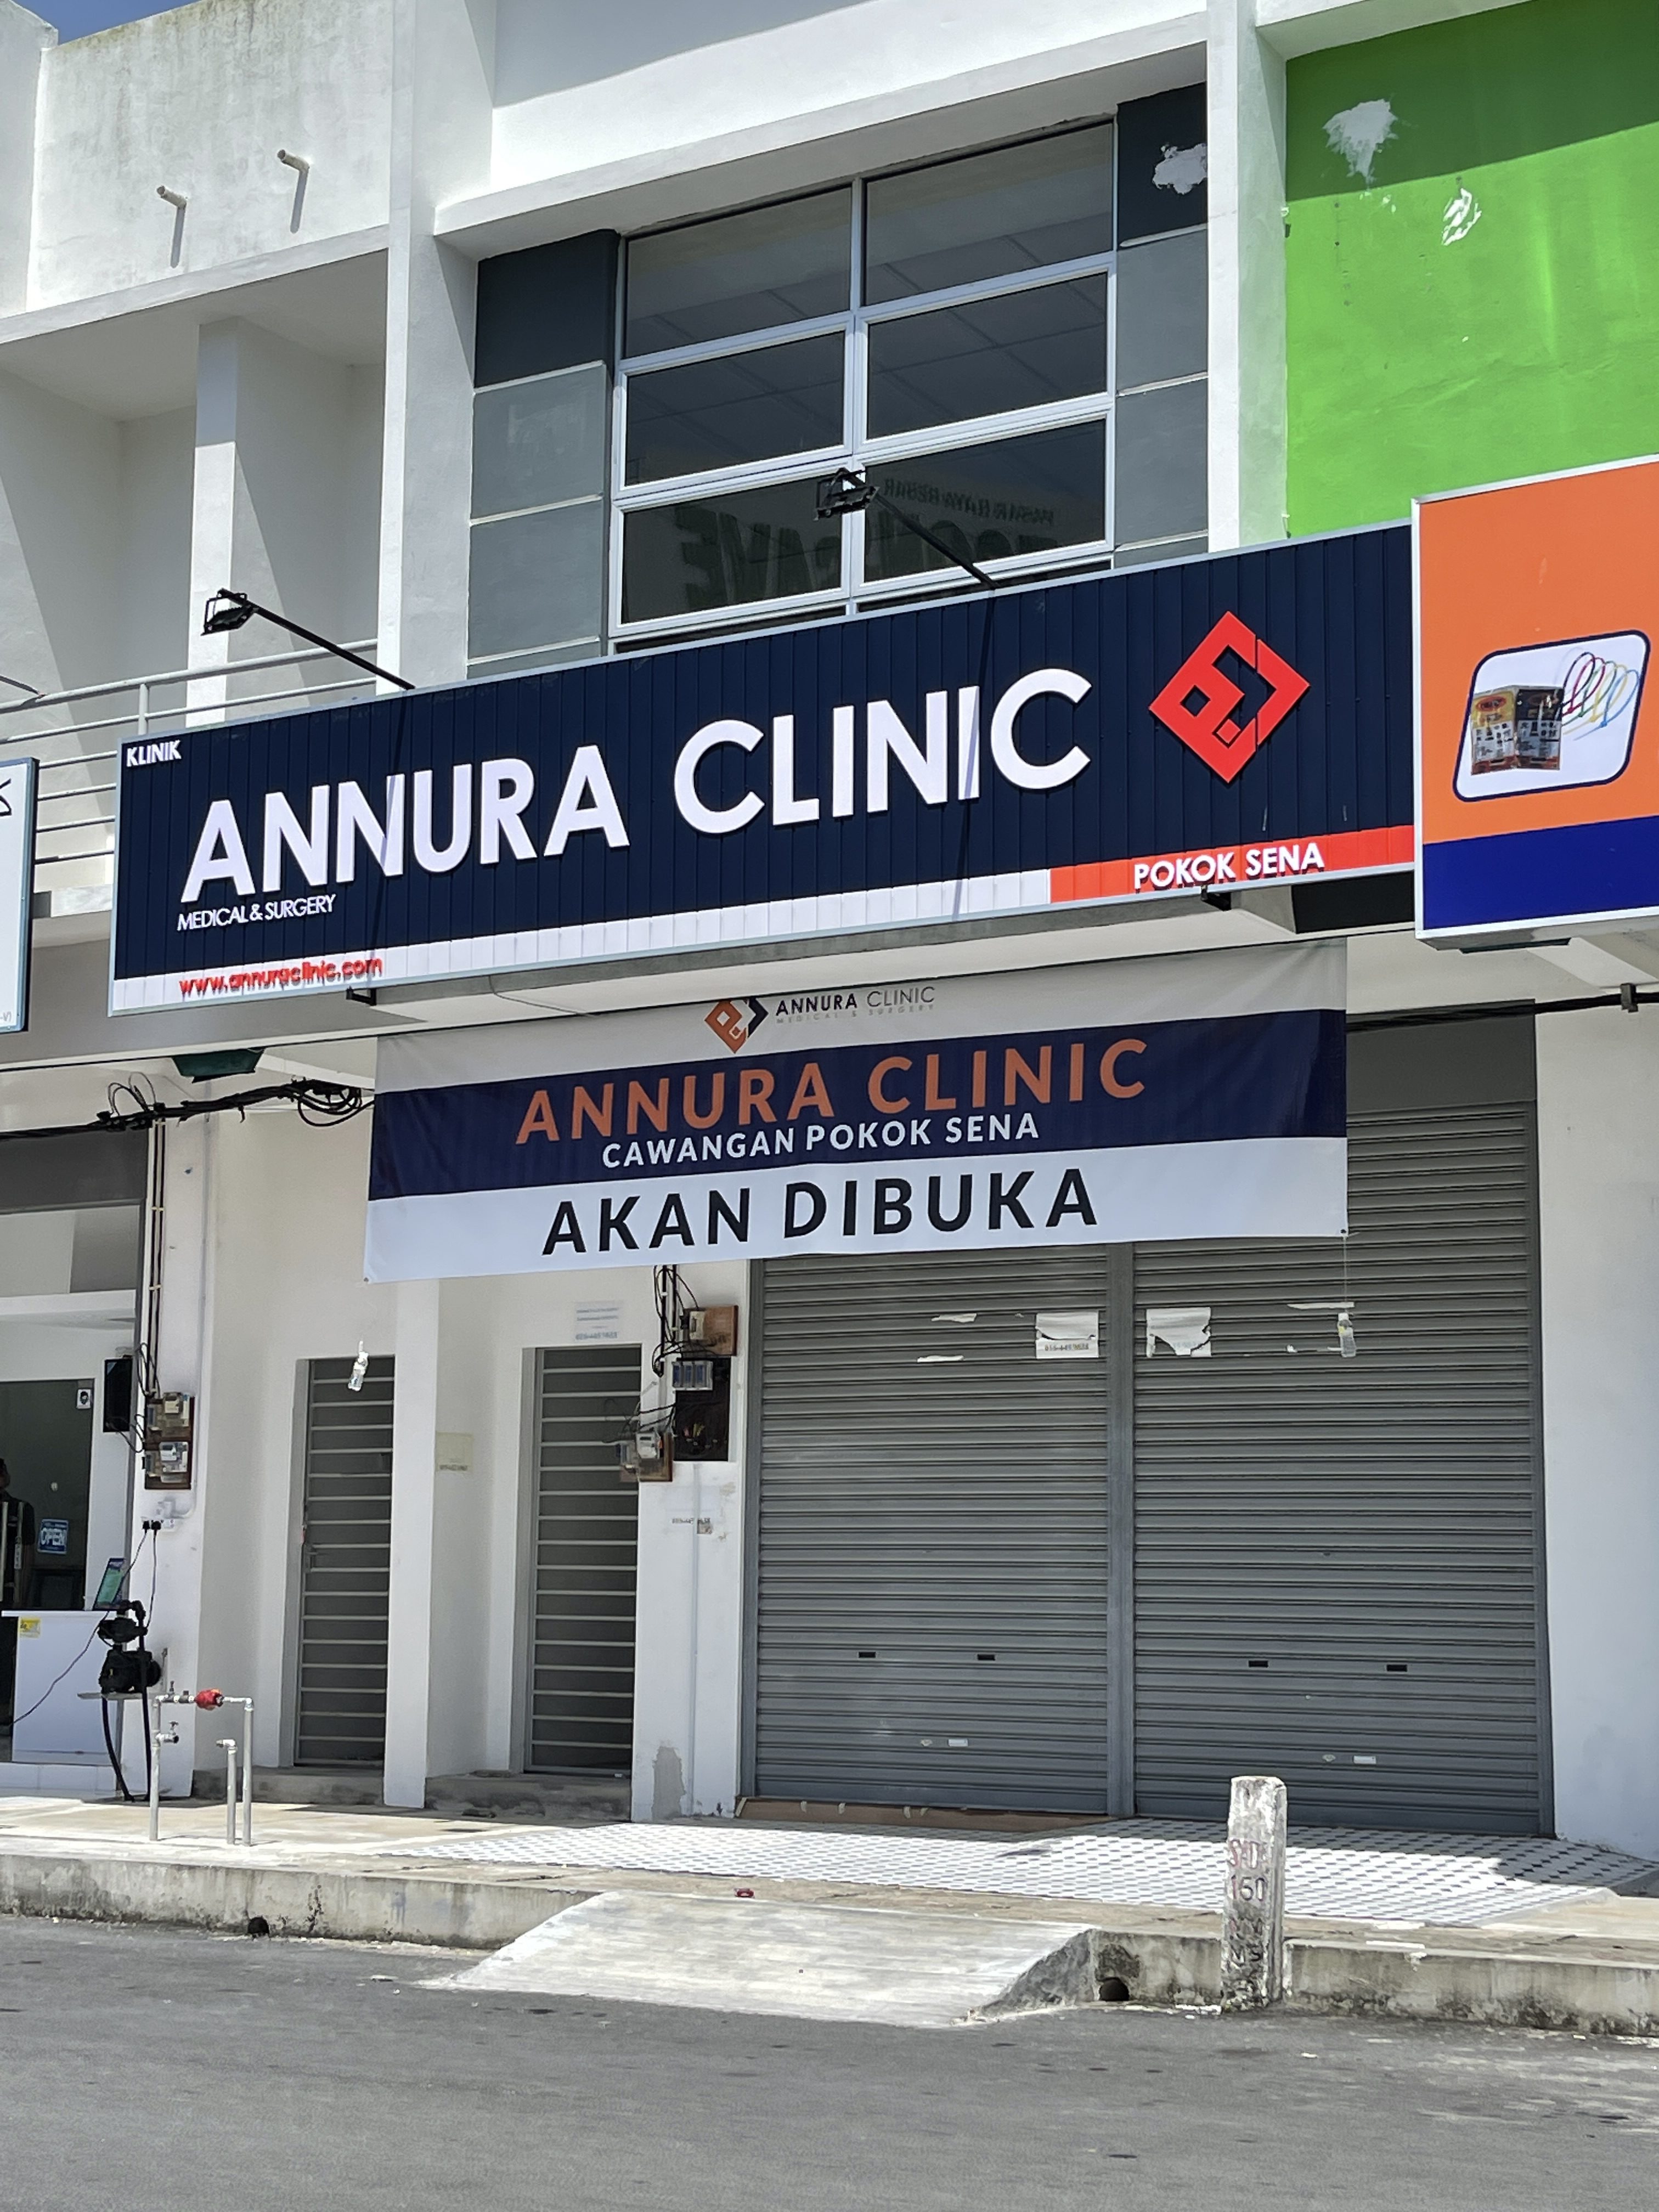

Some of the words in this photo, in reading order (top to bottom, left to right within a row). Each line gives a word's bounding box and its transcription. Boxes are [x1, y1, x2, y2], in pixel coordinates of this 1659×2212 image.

[127, 740, 182, 768] KLINIK
[180, 744, 630, 904] ANNURA
[674, 669, 1092, 834] CLINIC
[1134, 852, 1236, 889] POKOK
[1246, 843, 1325, 878] SENA
[177, 905, 248, 932] MEDICAL
[266, 894, 336, 919] SURGERY
[179, 957, 383, 994] www.annuraclinic.com
[776, 993, 857, 1016] ANNURA
[867, 986, 935, 1007] CLINIC
[516, 1062, 834, 1145] ANNURA
[868, 1039, 1147, 1114] CLINIC
[602, 1128, 794, 1169] CAWANGAN
[806, 1119, 932, 1150] POKOK
[945, 1113, 1039, 1144] SENA
[541, 1188, 751, 1256] AKAN
[783, 1169, 1097, 1239] DIBUKA
[40, 1527, 67, 1545] OPEN
